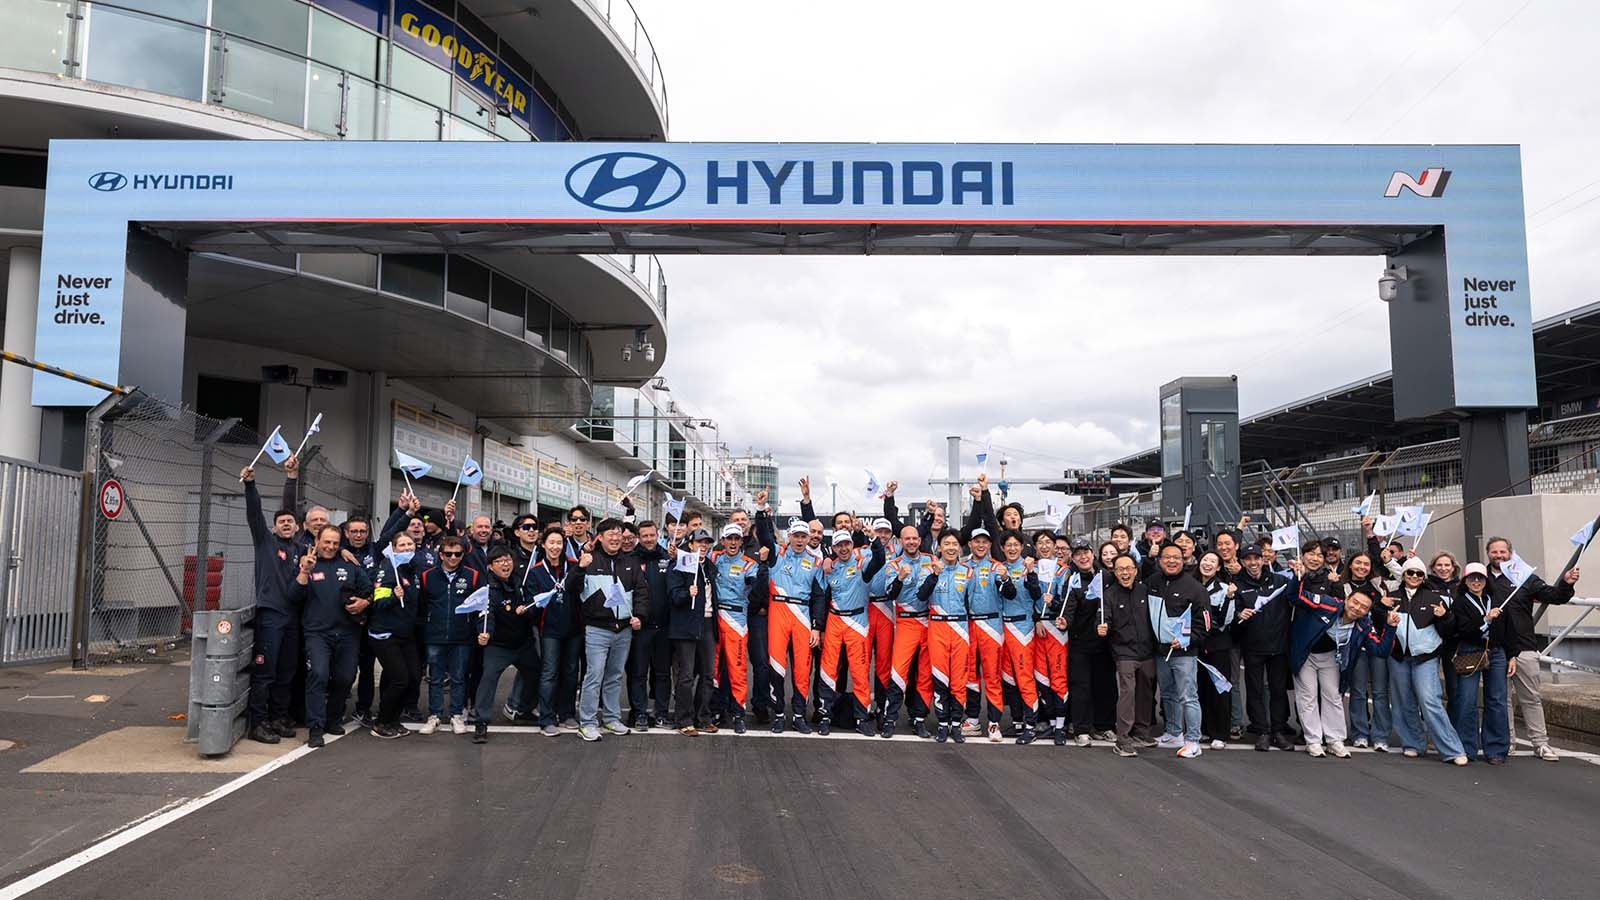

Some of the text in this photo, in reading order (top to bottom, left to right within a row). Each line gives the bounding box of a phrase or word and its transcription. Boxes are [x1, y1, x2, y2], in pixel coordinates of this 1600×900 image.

[133, 174, 233, 190] HYUNDAI
[706, 160, 1014, 205] HYUNDAI
[57, 274, 112, 289] Never
[1463, 277, 1517, 292] Never
[55, 290, 90, 308] just
[1464, 293, 1498, 312] just
[53, 309, 106, 326] drive.
[1465, 311, 1515, 327] drive.
[1560, 400, 1583, 416] BMW
